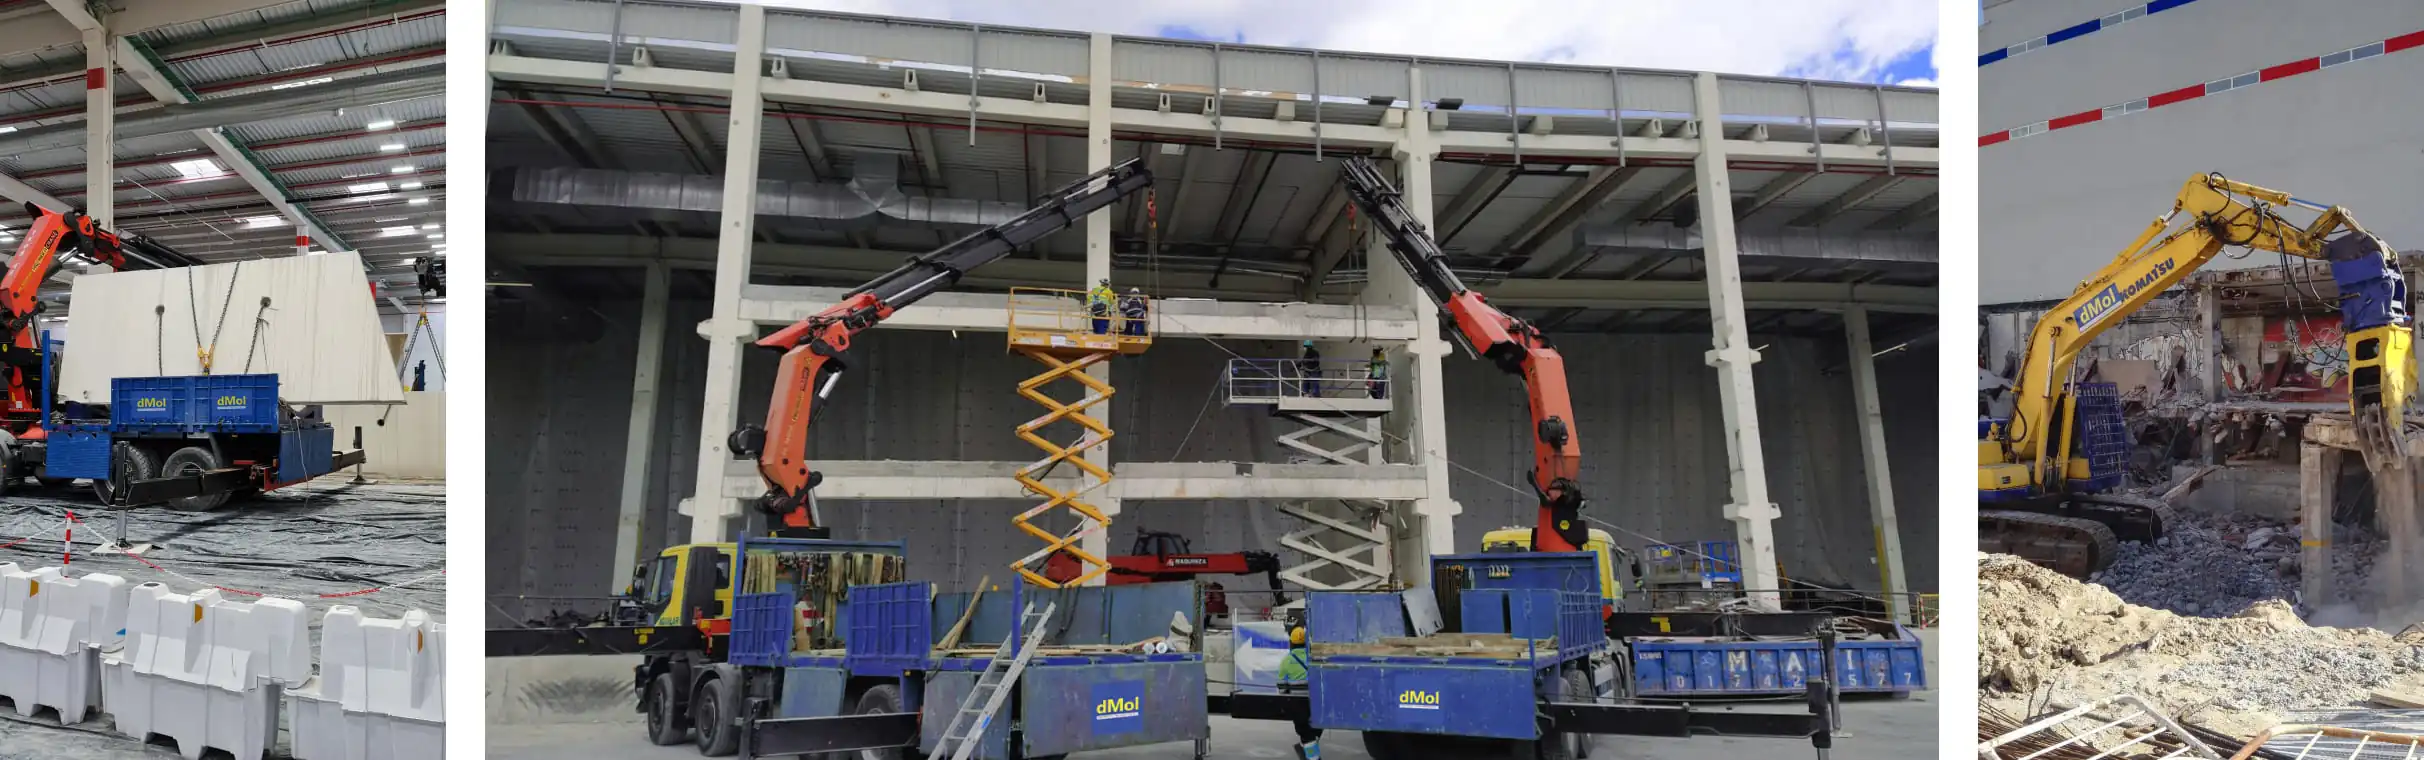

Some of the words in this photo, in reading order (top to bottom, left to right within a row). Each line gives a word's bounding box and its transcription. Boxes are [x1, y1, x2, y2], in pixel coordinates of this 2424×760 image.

[2120, 257, 2175, 301] KOMATSU
[2080, 287, 2116, 324] dMol
[137, 398, 166, 408] dMol
[217, 396, 247, 406] dMol
[1096, 696, 1139, 714] dMol
[1399, 690, 1439, 704] dMol
